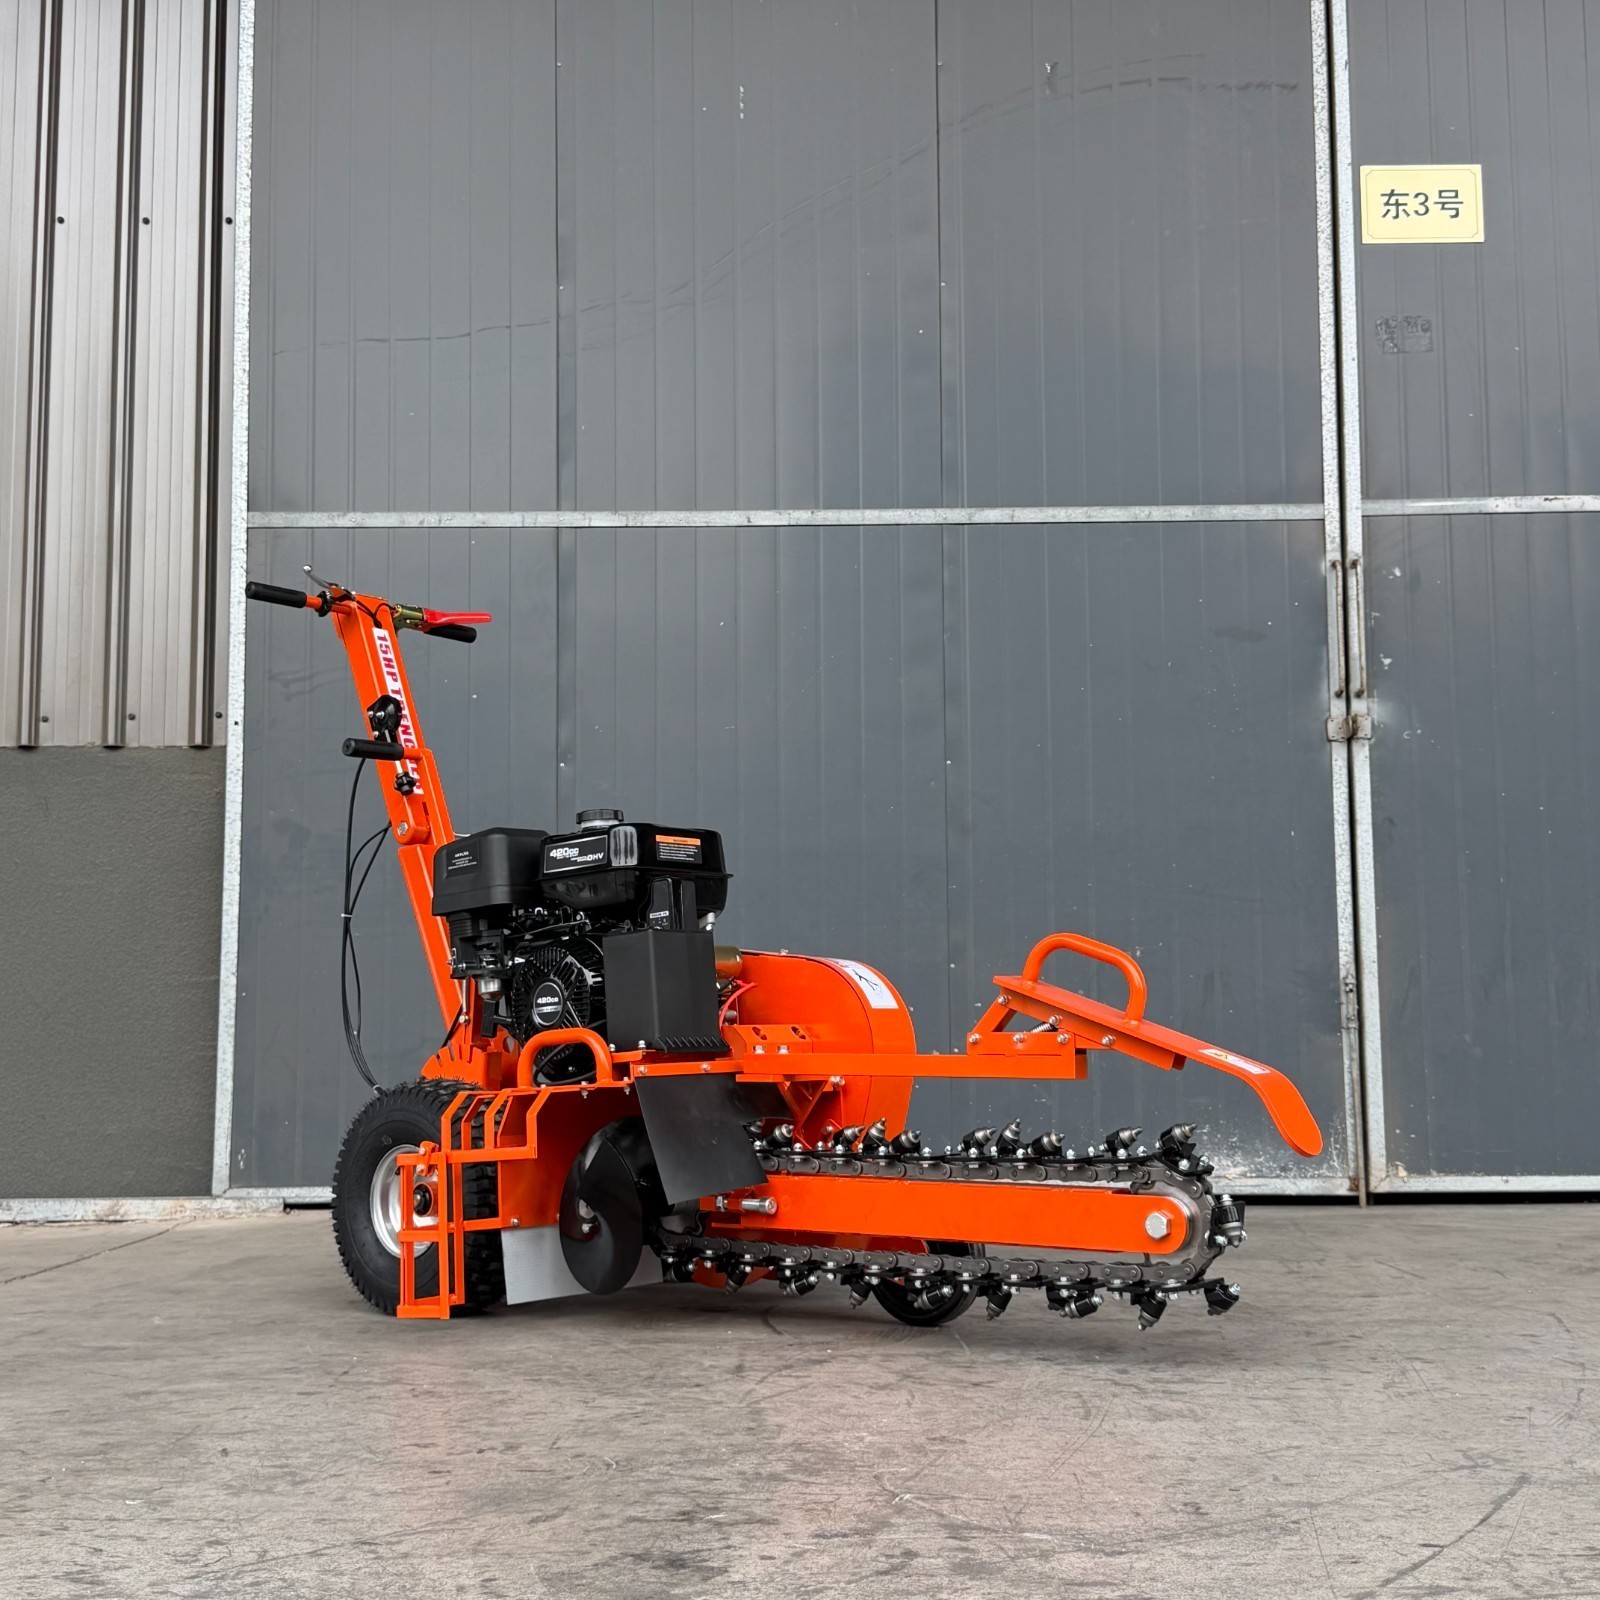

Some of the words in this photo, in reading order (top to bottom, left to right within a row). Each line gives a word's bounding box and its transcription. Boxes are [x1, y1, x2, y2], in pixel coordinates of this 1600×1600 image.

[1380, 188, 1464, 219] 东3号
[377, 633, 399, 683] 15HP
[390, 687, 422, 790] TENC
